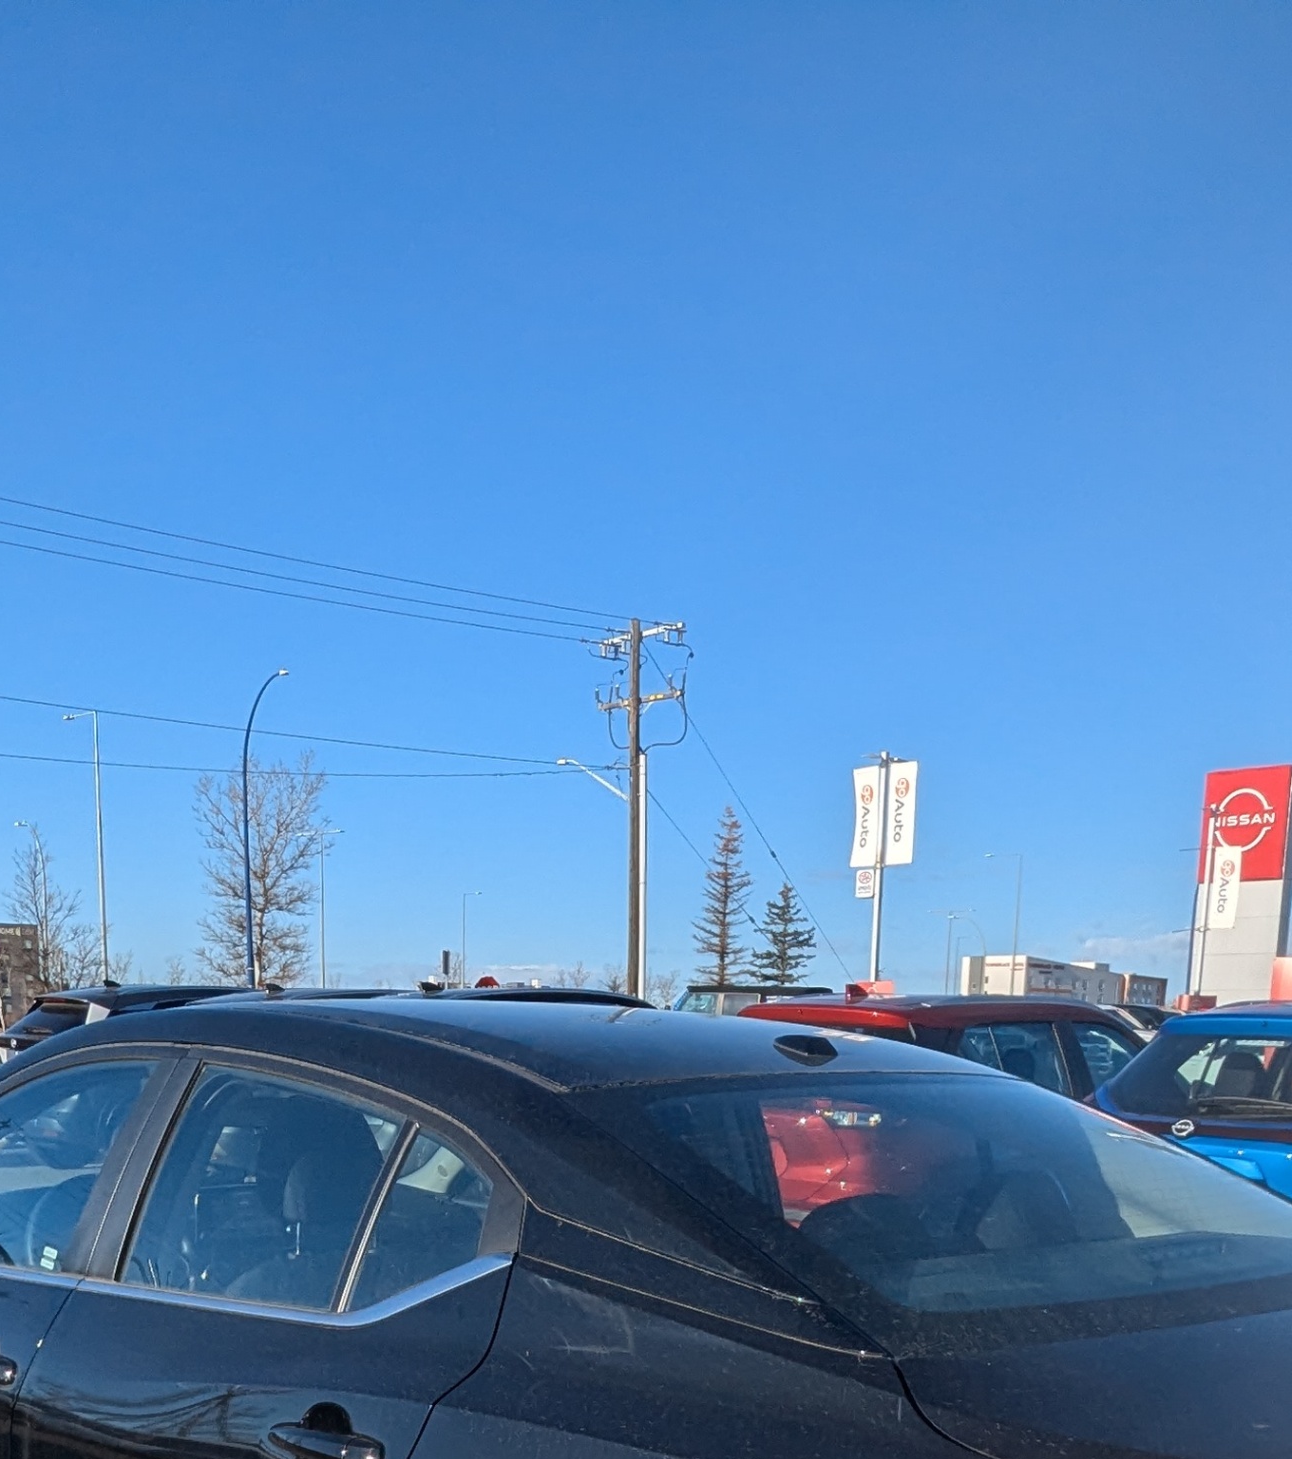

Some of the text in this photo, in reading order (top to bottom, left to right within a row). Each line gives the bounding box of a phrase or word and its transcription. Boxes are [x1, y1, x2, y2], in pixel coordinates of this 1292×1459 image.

[859, 806, 870, 848] Auto
[893, 799, 904, 843] Auto
[1214, 812, 1275, 828] NISSAN
[1217, 878, 1229, 914] Auto
